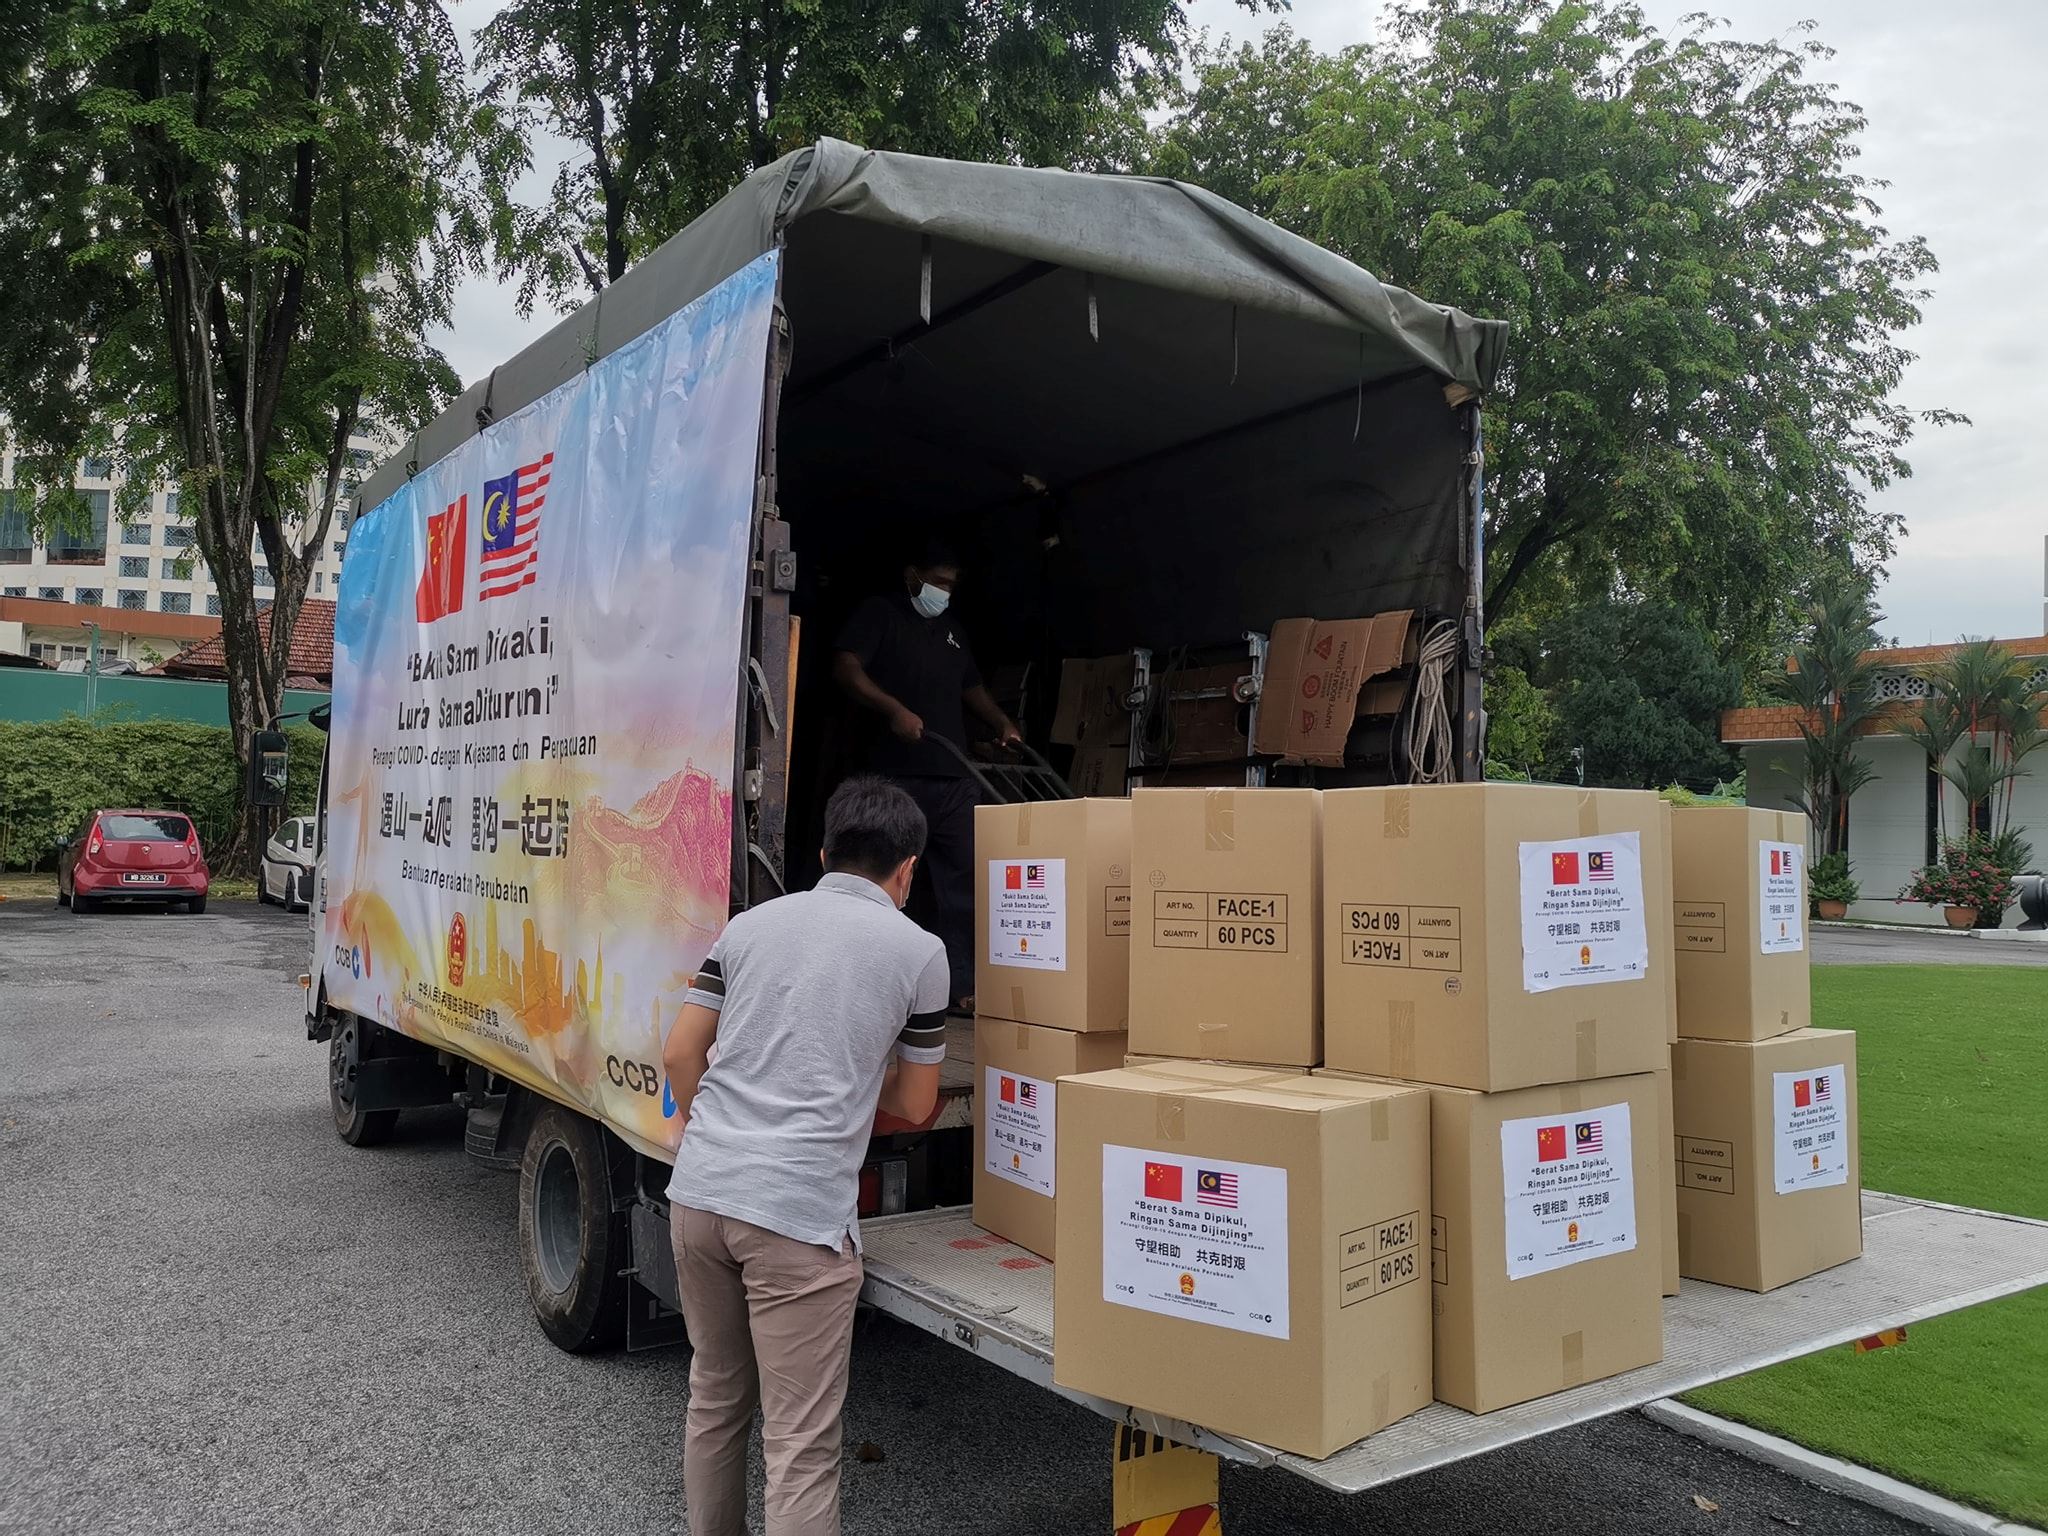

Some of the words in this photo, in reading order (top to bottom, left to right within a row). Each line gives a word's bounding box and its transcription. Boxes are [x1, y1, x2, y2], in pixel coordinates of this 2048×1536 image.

[430, 745, 461, 770] dengan
[475, 873, 528, 904] Perubatan
[1572, 888, 1592, 897] Sama
[1182, 902, 1195, 910] NO.
[1217, 899, 1275, 918] FACE-1
[1543, 901, 1569, 911] Ringan
[1571, 900, 1590, 908] Sama
[1682, 911, 1716, 919] QUANTITY
[1351, 911, 1380, 930] PCS
[1384, 911, 1400, 930] 60
[1417, 918, 1451, 927] QUANTITY
[1548, 923, 1580, 937] 守望相助
[1162, 929, 1199, 938] QUANTITY
[1218, 926, 1236, 944] 60
[1241, 927, 1275, 946] PCS
[335, 944, 351, 969] CCB
[1352, 939, 1401, 961] FACE-1
[1435, 950, 1450, 959] ART
[606, 1054, 659, 1097] CCB
[1691, 1147, 1724, 1157] QUANTITY
[1559, 1162, 1580, 1172] Sama
[1528, 1179, 1556, 1189] Ringan
[1557, 1175, 1578, 1185] Sama
[1135, 1200, 1168, 1214] “Berat
[1171, 1206, 1200, 1219] Sama
[1204, 1211, 1247, 1228] Dipikul,
[1532, 1199, 1569, 1217] 守望相助
[1130, 1211, 1165, 1226] Ringan
[1168, 1218, 1197, 1232] Sama
[1201, 1223, 1254, 1242] Dijinjing”
[1380, 1220, 1413, 1251] FACE-1
[1135, 1237, 1182, 1259] 守望相助
[1196, 1248, 1247, 1271] 共克时艰
[1380, 1261, 1392, 1284] 60
[1394, 1253, 1413, 1280] PCS
[1249, 1312, 1264, 1321] CCB
